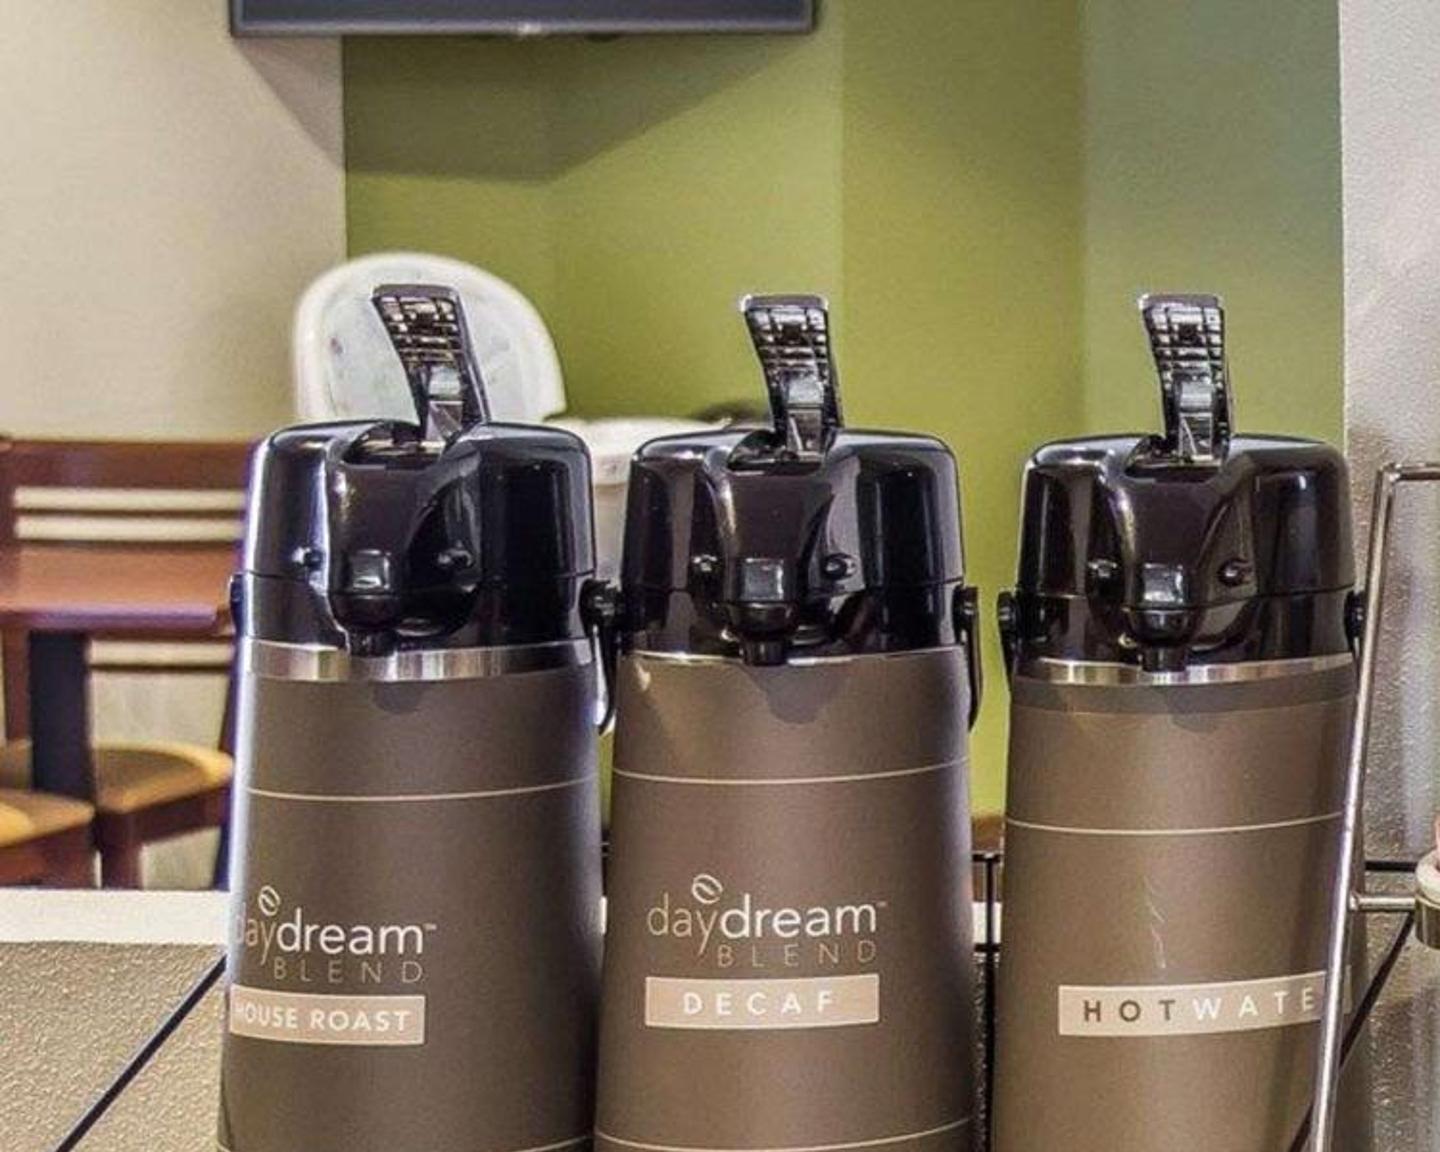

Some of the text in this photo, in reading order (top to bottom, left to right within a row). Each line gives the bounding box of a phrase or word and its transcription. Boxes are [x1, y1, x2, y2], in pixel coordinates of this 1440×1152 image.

[647, 891, 877, 956] daydream
[717, 940, 876, 968] BLEND
[273, 956, 424, 984] BLEND
[682, 989, 834, 1016] DECAF
[1083, 987, 1316, 1022] HOT WATE
[310, 1009, 412, 1032] ROAST
